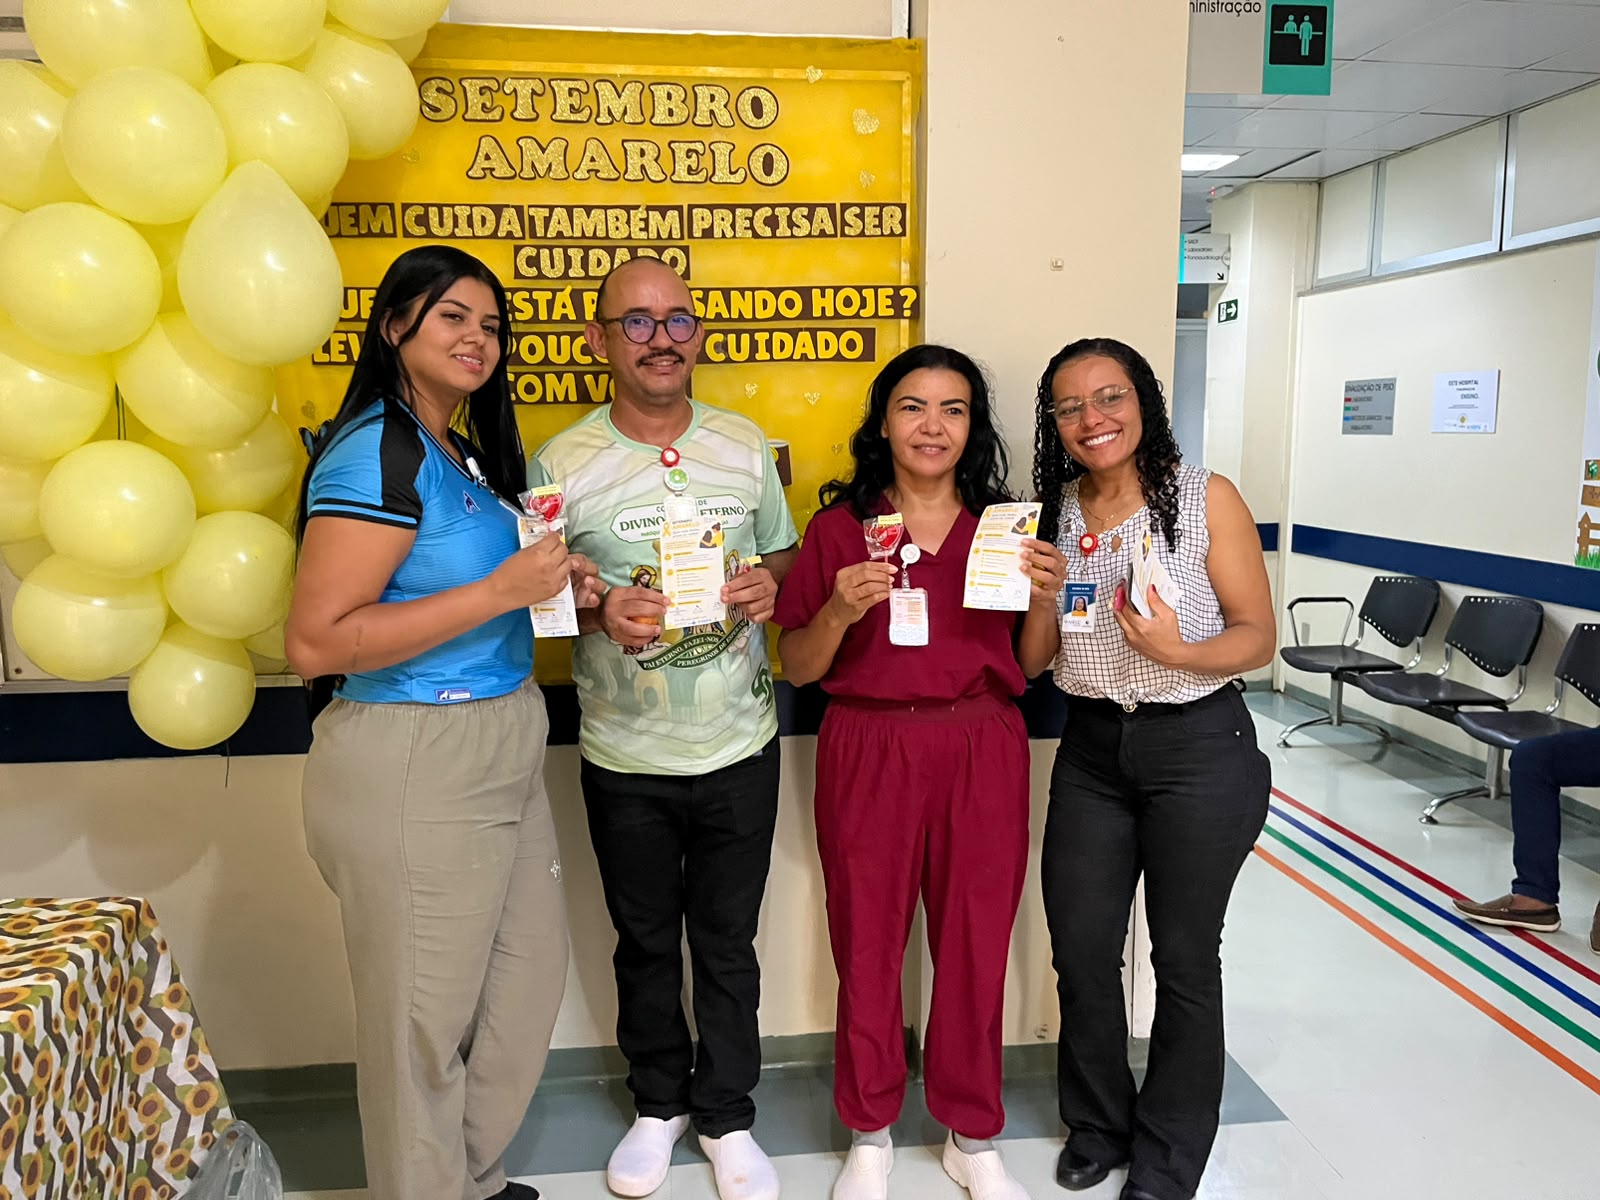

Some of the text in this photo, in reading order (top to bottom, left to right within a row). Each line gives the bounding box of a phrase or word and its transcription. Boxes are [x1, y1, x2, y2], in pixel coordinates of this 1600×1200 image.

[419, 77, 779, 129] SETEMBRO
[466, 135, 789, 186] AMARELO
[323, 204, 903, 240] UEM CUIDA TAMBÉM PRECISA SER
[516, 246, 687, 278] CUIDAO
[340, 289, 377, 319] UE
[505, 285, 577, 321] STÁ
[507, 334, 609, 365] OUC
[705, 331, 864, 362] CUIDADO
